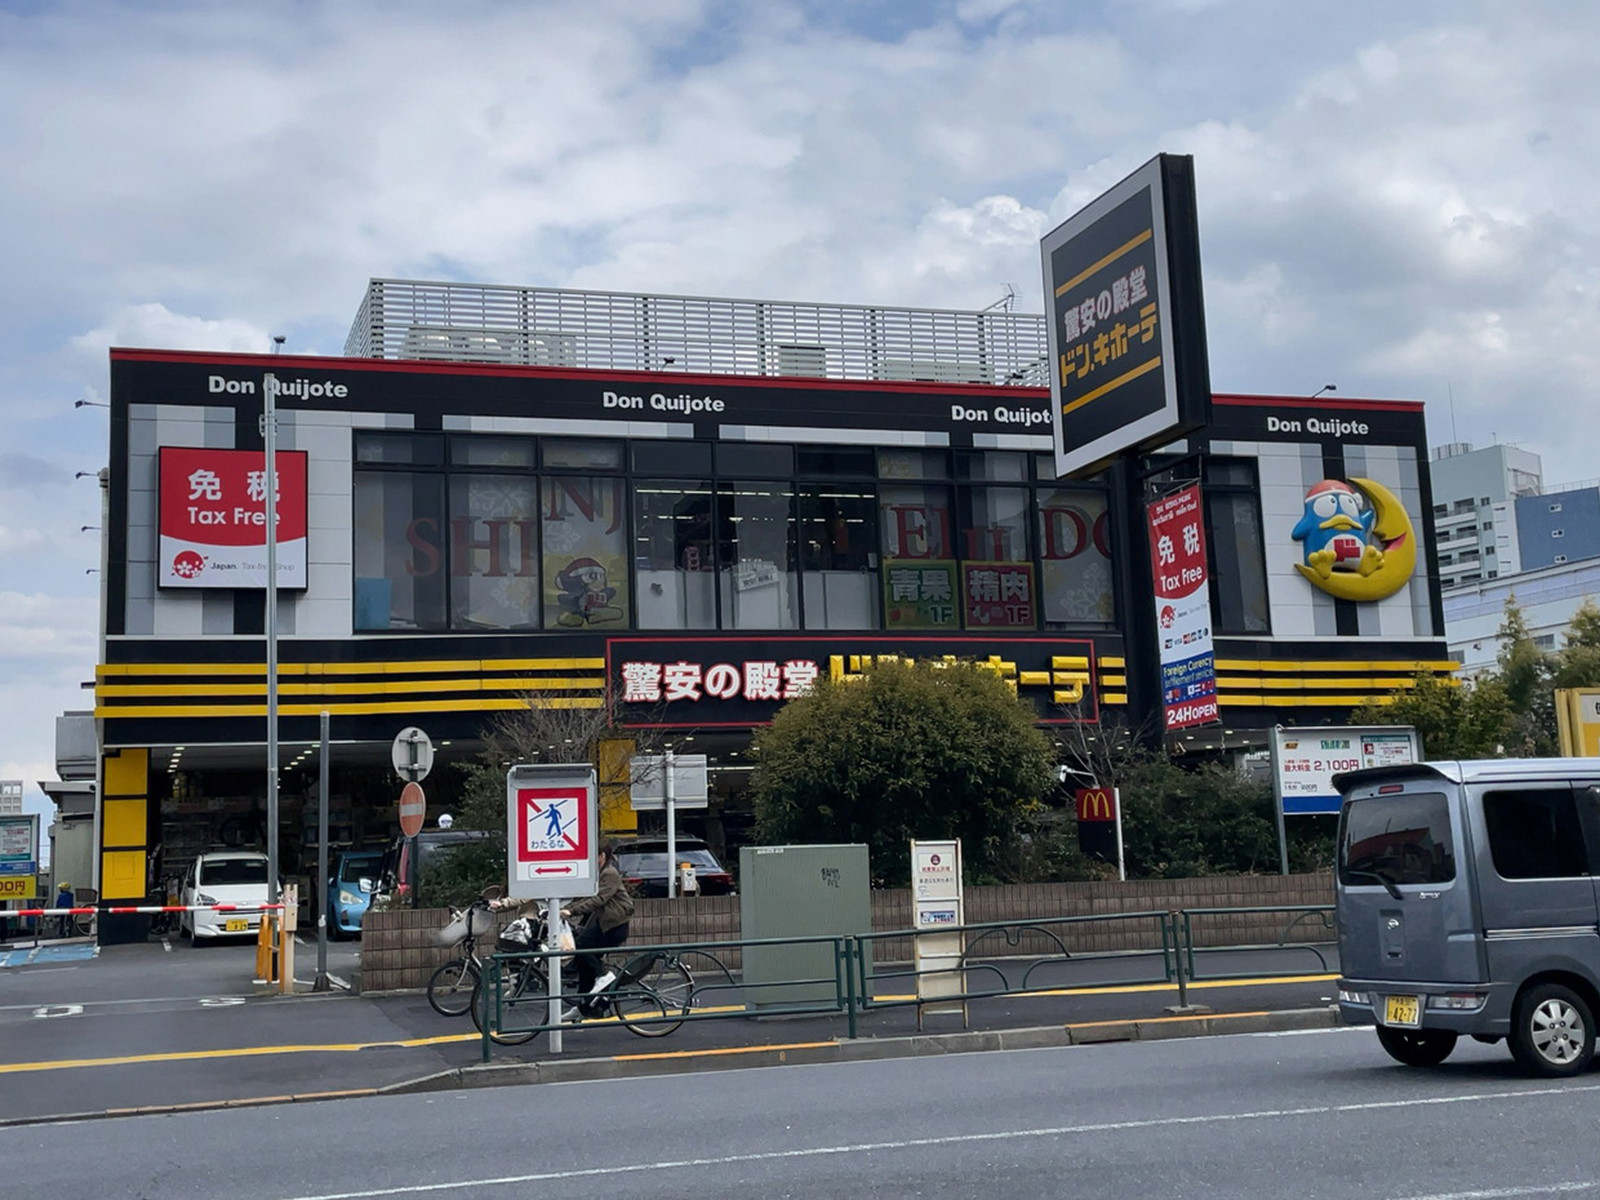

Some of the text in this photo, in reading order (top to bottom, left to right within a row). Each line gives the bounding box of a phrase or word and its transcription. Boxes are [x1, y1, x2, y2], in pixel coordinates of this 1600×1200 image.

[1064, 265, 1148, 343] 驚安の殿堂
[209, 375, 255, 395] Don
[603, 391, 725, 415] Don Quijote
[951, 405, 1053, 427] Don Quijot
[1267, 416, 1369, 437] Don Quijote
[188, 507, 226, 524] Tax
[1157, 522, 1200, 567] 免税
[889, 569, 951, 602] 青果
[969, 570, 1030, 602] 精肉
[1160, 566, 1202, 593] Tax Free
[929, 605, 954, 624] 1F
[1006, 605, 1031, 624] 1F
[1163, 656, 1212, 677] Foreign Currency
[622, 659, 818, 702] 驚安の殿堂
[1314, 759, 1359, 772] 2,100円
[531, 840, 565, 849] わたるな
